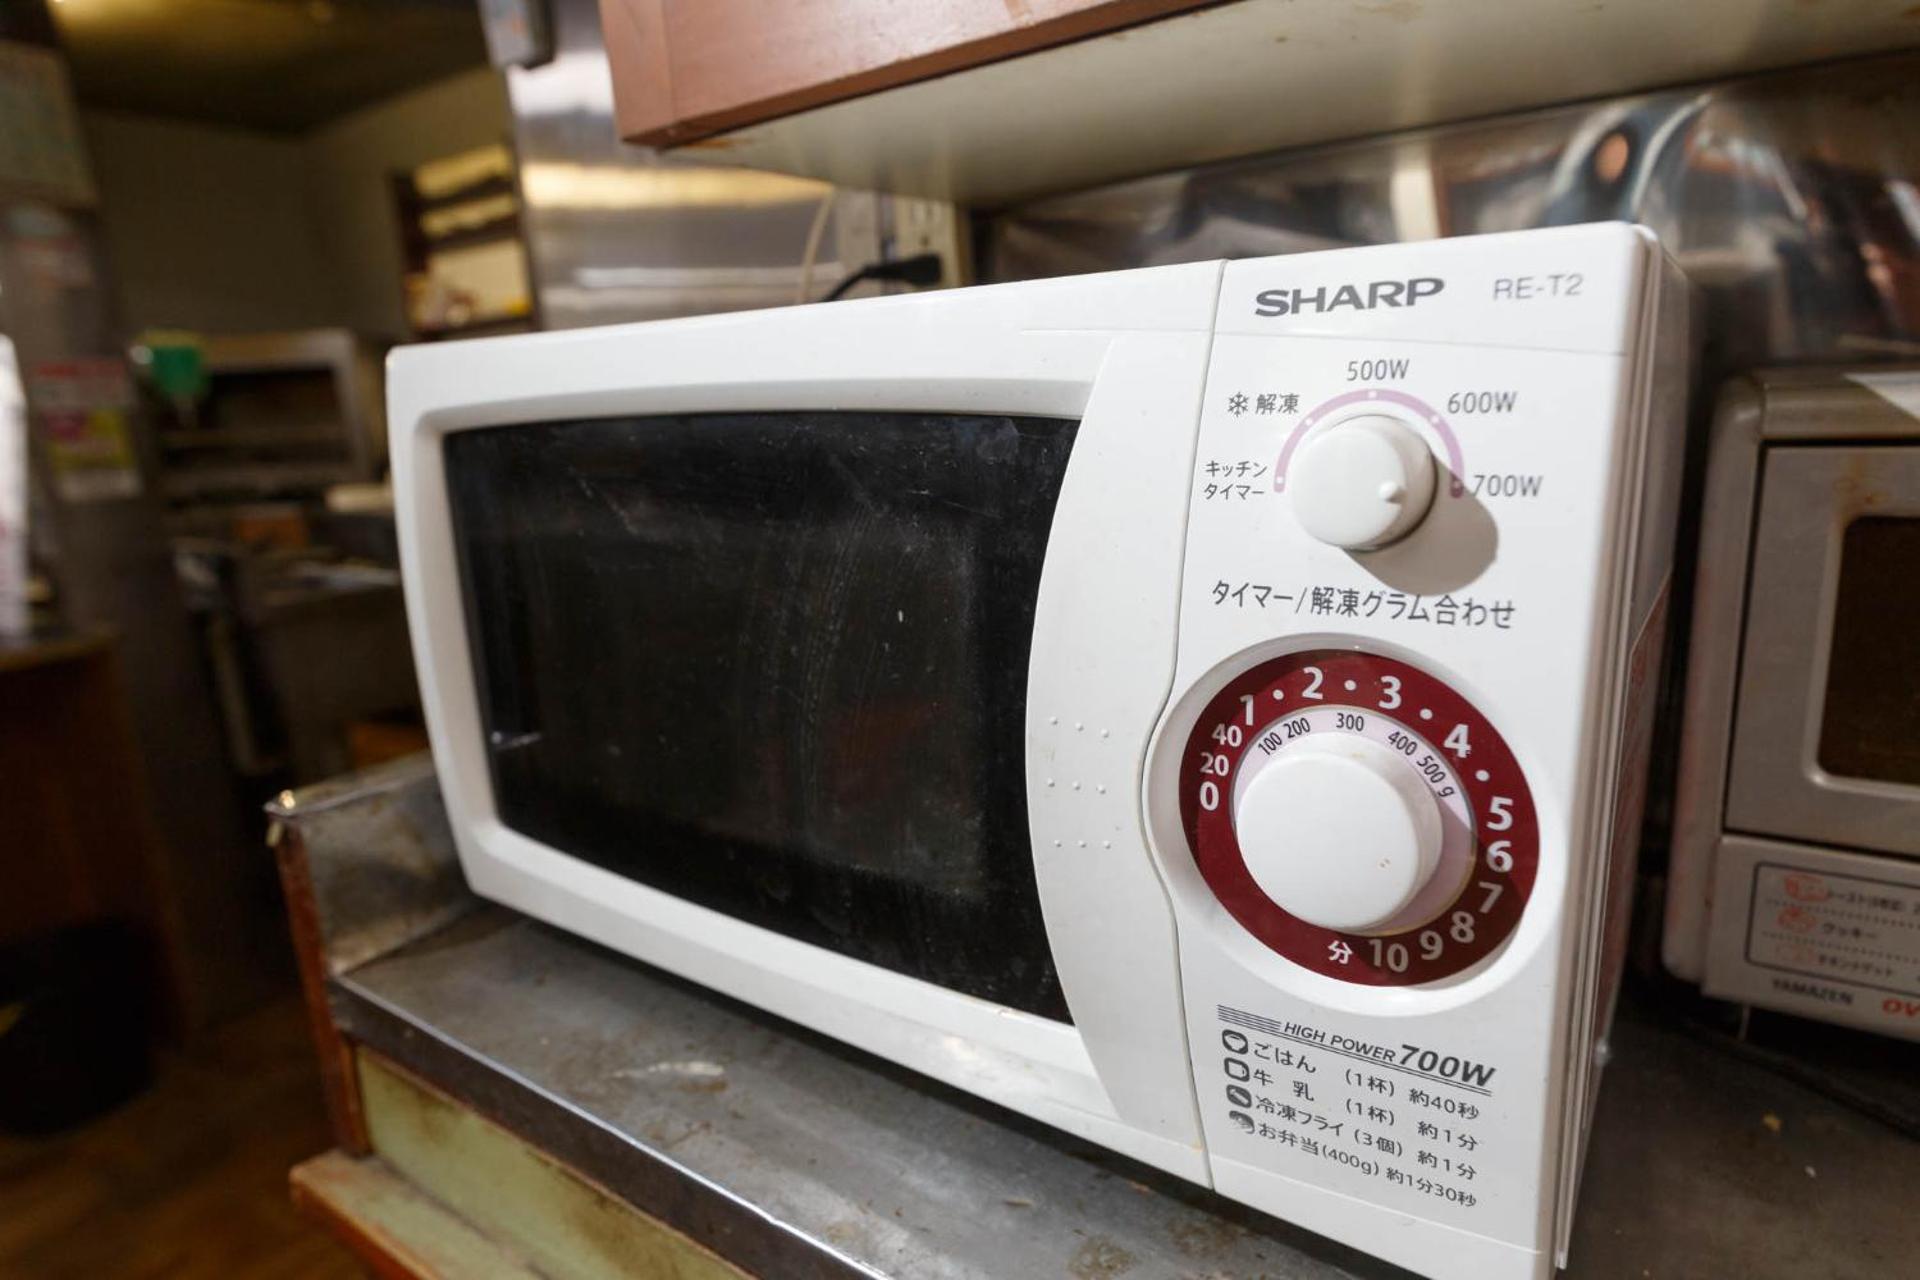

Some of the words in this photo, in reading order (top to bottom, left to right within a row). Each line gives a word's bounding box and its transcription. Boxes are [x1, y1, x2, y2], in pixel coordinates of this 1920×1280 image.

[1255, 277, 1445, 317] SHARP
[1493, 274, 1585, 300] RE-T2
[1346, 359, 1410, 381] 500W
[1255, 393, 1300, 415] 解凍
[1448, 391, 1518, 414] 600W
[1204, 460, 1268, 479] キッチン
[1204, 483, 1266, 500] タイマー
[1473, 474, 1544, 498] 700W
[1302, 666, 1324, 700] 2
[1378, 675, 1402, 710] 3
[1240, 694, 1255, 726] 1
[1212, 723, 1242, 747] 40
[1444, 724, 1471, 759] 4
[1200, 752, 1230, 777] 20
[1258, 734, 1283, 756] 100
[1283, 717, 1311, 741] 200
[1336, 713, 1365, 732] 300
[1387, 730, 1418, 757] 400
[1416, 755, 1446, 784] 500
[1437, 786, 1456, 799] g
[1199, 782, 1220, 811] 0
[1487, 797, 1513, 831] 5
[1487, 840, 1513, 873] 6
[1477, 882, 1503, 913] 7
[1450, 911, 1475, 944] 8
[1327, 940, 1353, 965] 分
[1368, 938, 1409, 973] 10
[1419, 930, 1443, 961] 9
[1284, 1022, 1326, 1043] HIGH
[1330, 1035, 1397, 1063] POWER
[1399, 1044, 1498, 1087] 700W
[1253, 1042, 1316, 1074] ごはん
[1345, 1069, 1395, 1097] (1杯)
[1408, 1088, 1480, 1120] 約40秒
[1255, 1095, 1344, 1137] 冷凍フライ
[1346, 1098, 1395, 1125] (1杯)
